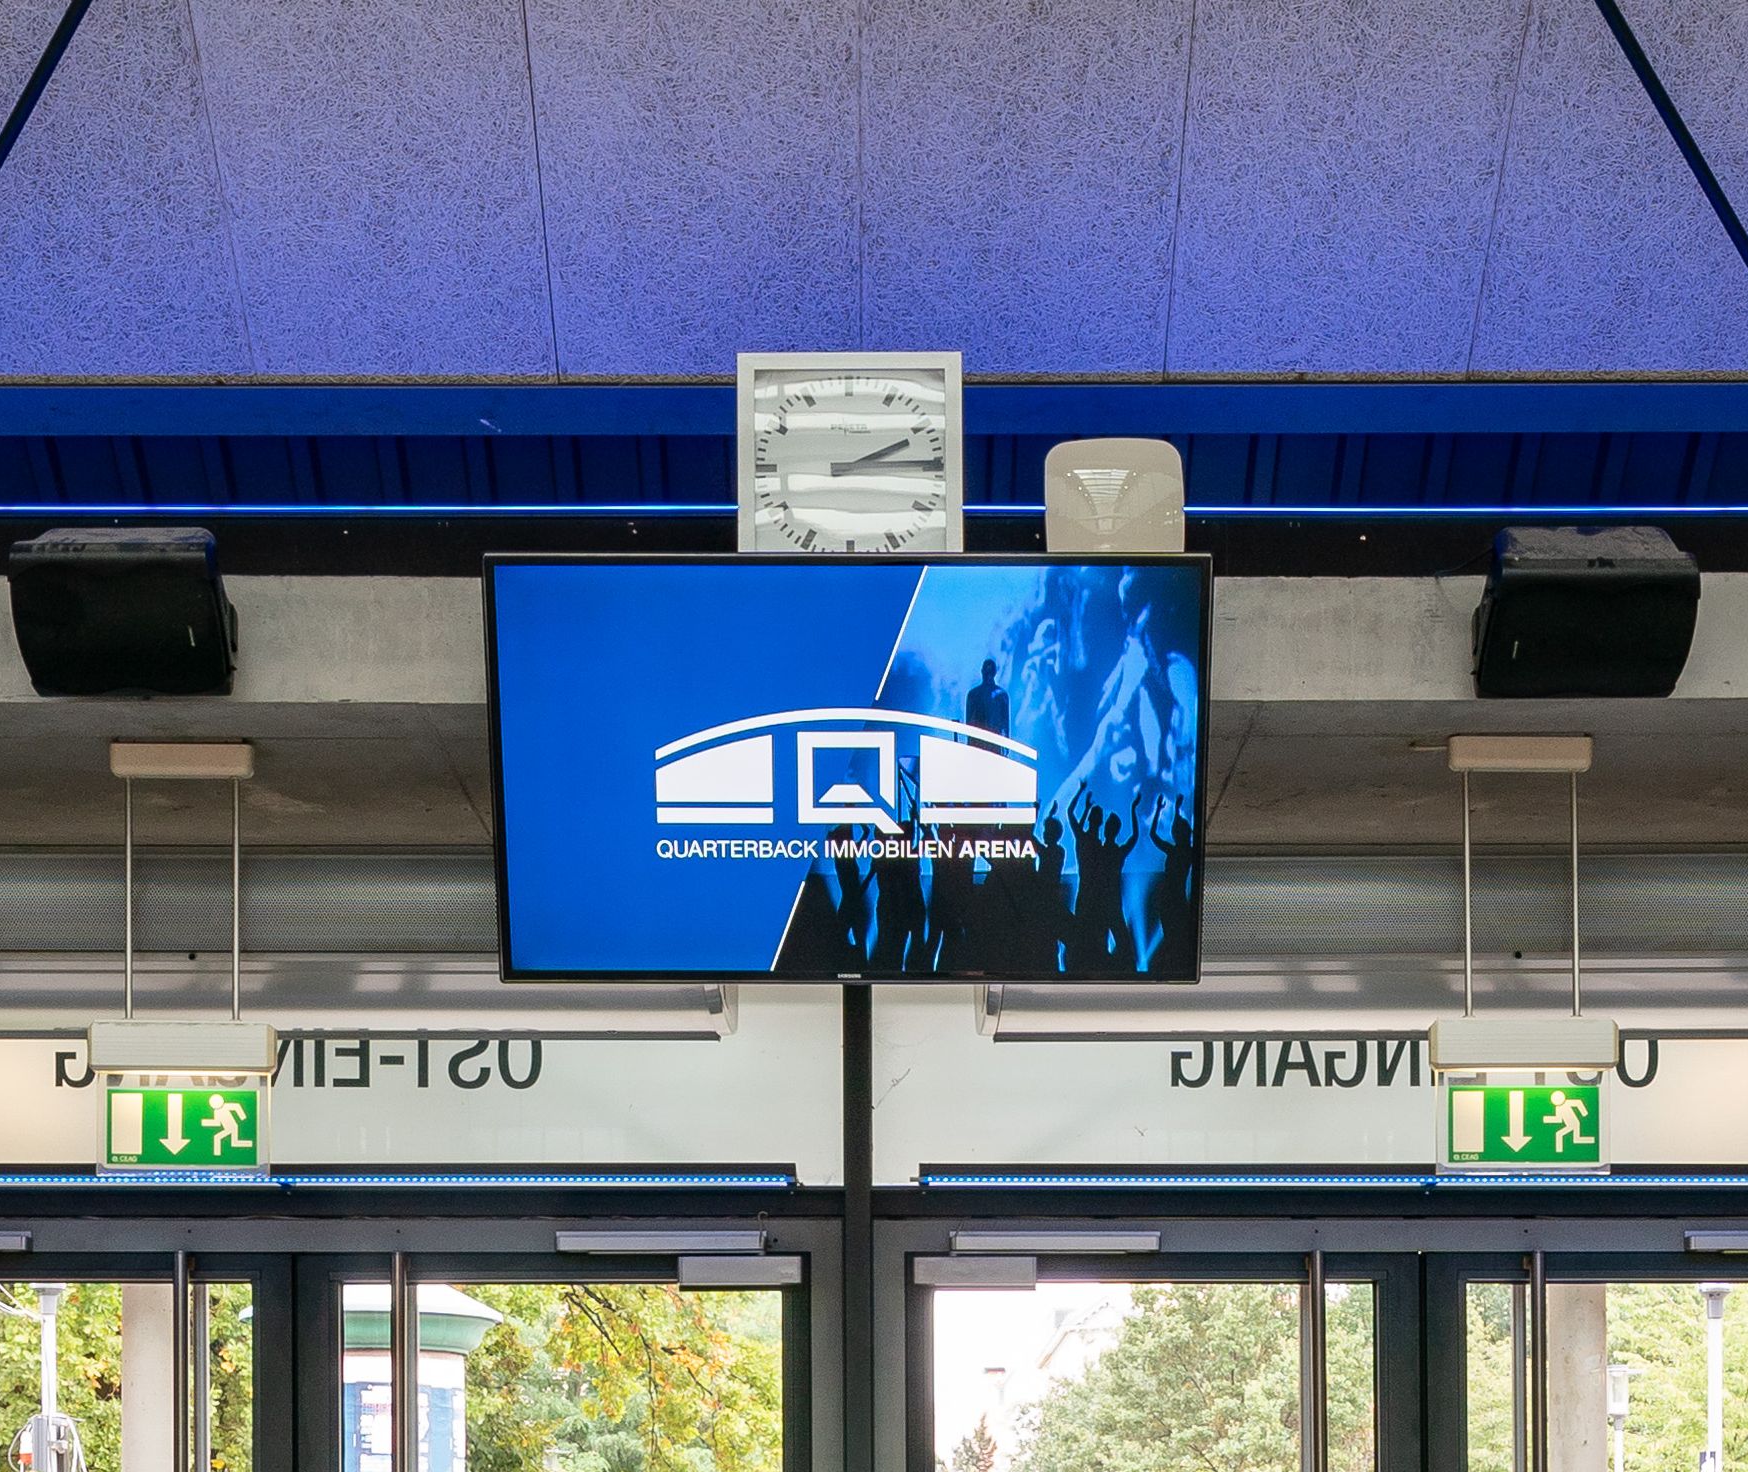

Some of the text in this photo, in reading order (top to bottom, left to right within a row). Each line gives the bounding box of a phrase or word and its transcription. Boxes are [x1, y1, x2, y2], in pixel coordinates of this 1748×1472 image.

[656, 839, 1037, 860] QUARTERBACK IMMOBILIEN ARENA
